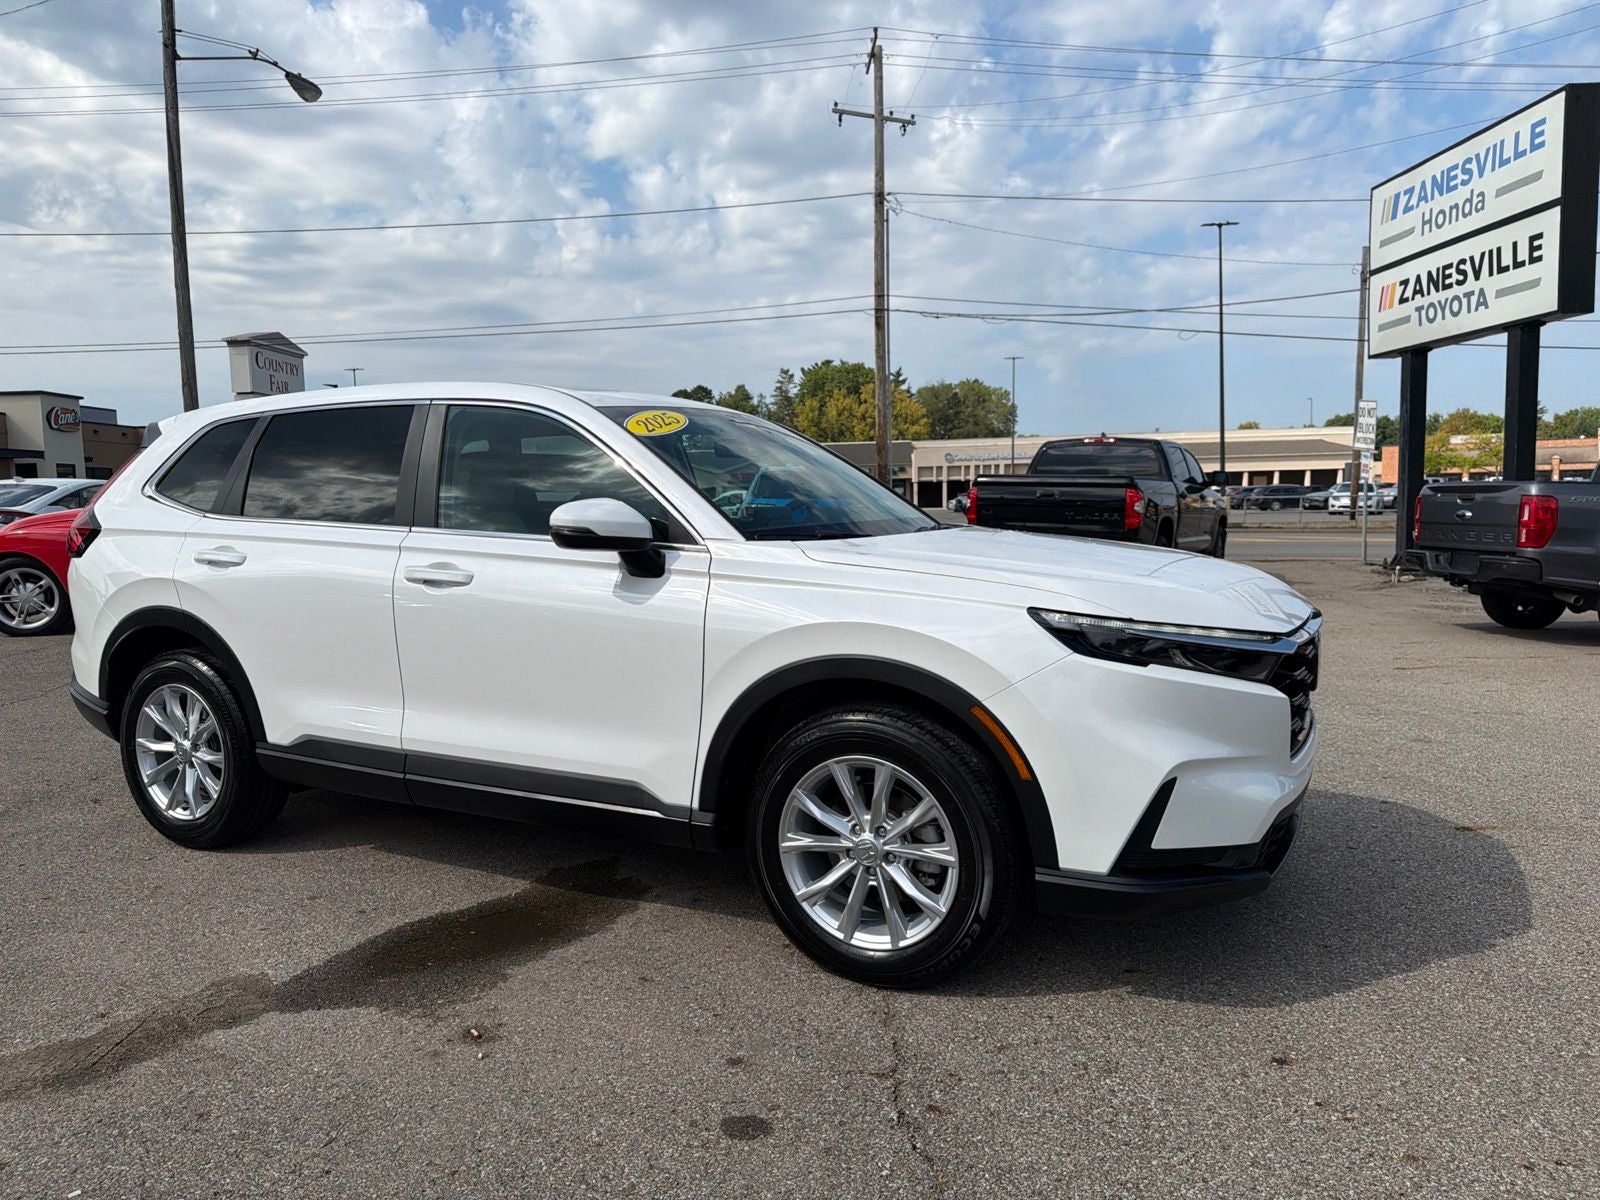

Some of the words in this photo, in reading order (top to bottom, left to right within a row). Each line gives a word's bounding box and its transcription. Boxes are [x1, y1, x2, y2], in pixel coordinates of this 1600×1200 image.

[1402, 117, 1547, 214] ZANESVILLE
[1421, 189, 1486, 236] Honda
[1398, 232, 1544, 305] ZANESVILLE
[1415, 287, 1489, 326] TOYOTA
[255, 350, 299, 377] COUNTRY
[636, 412, 680, 433] 2025
